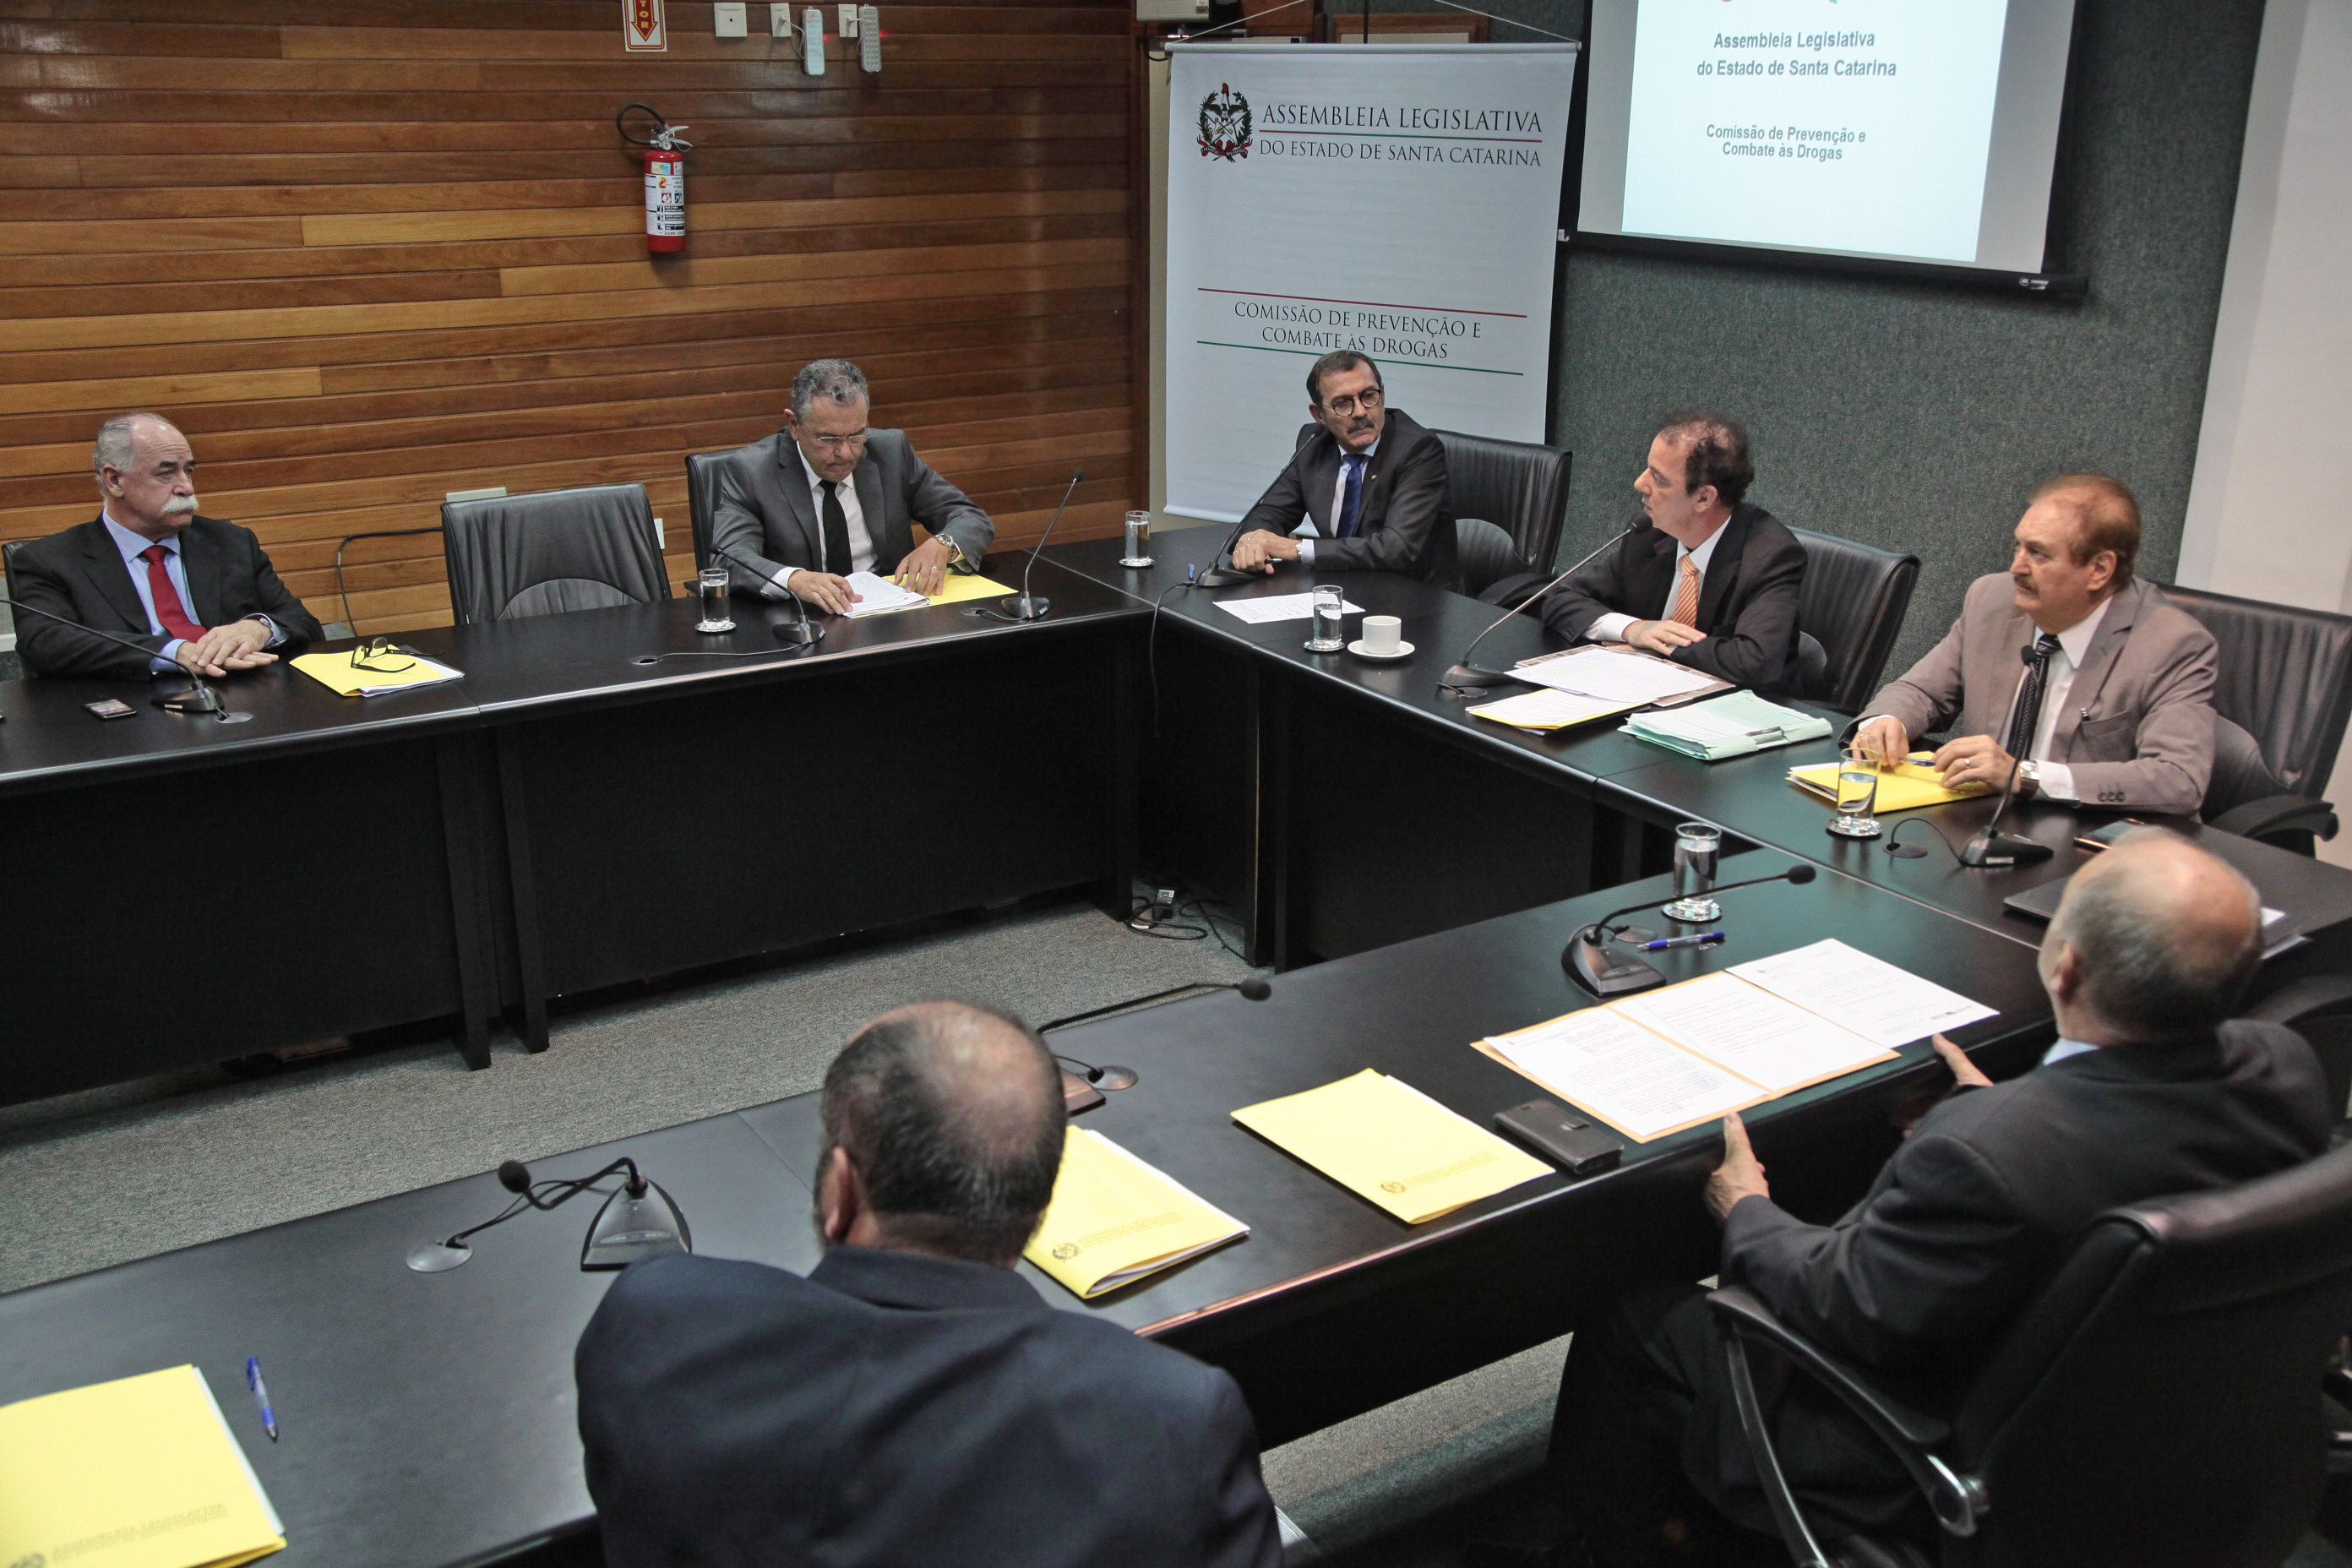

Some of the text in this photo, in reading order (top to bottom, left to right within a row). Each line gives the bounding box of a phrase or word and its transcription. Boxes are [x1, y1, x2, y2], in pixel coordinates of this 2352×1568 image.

[1713, 30, 1876, 52] Assembleia Legislativa
[1696, 59, 1897, 77] do Estado de Santa Catarina
[1262, 104, 1544, 133] ASSEMBLEIA LEGISLATIVA
[1707, 123, 1866, 145] Comissão de Prevenção e
[1260, 140, 1285, 155] DO
[1290, 141, 1353, 159] ESTADO
[1359, 144, 1382, 160] DE
[1388, 145, 1444, 163] SANTA
[1449, 147, 1541, 167] CATARINA
[1723, 141, 1843, 162] Combate às Drogas
[1234, 302, 1481, 339] COMISSÃO DE PREVENÇÃO E
[1262, 326, 1448, 359] COMBATE ÀS DROGAS
